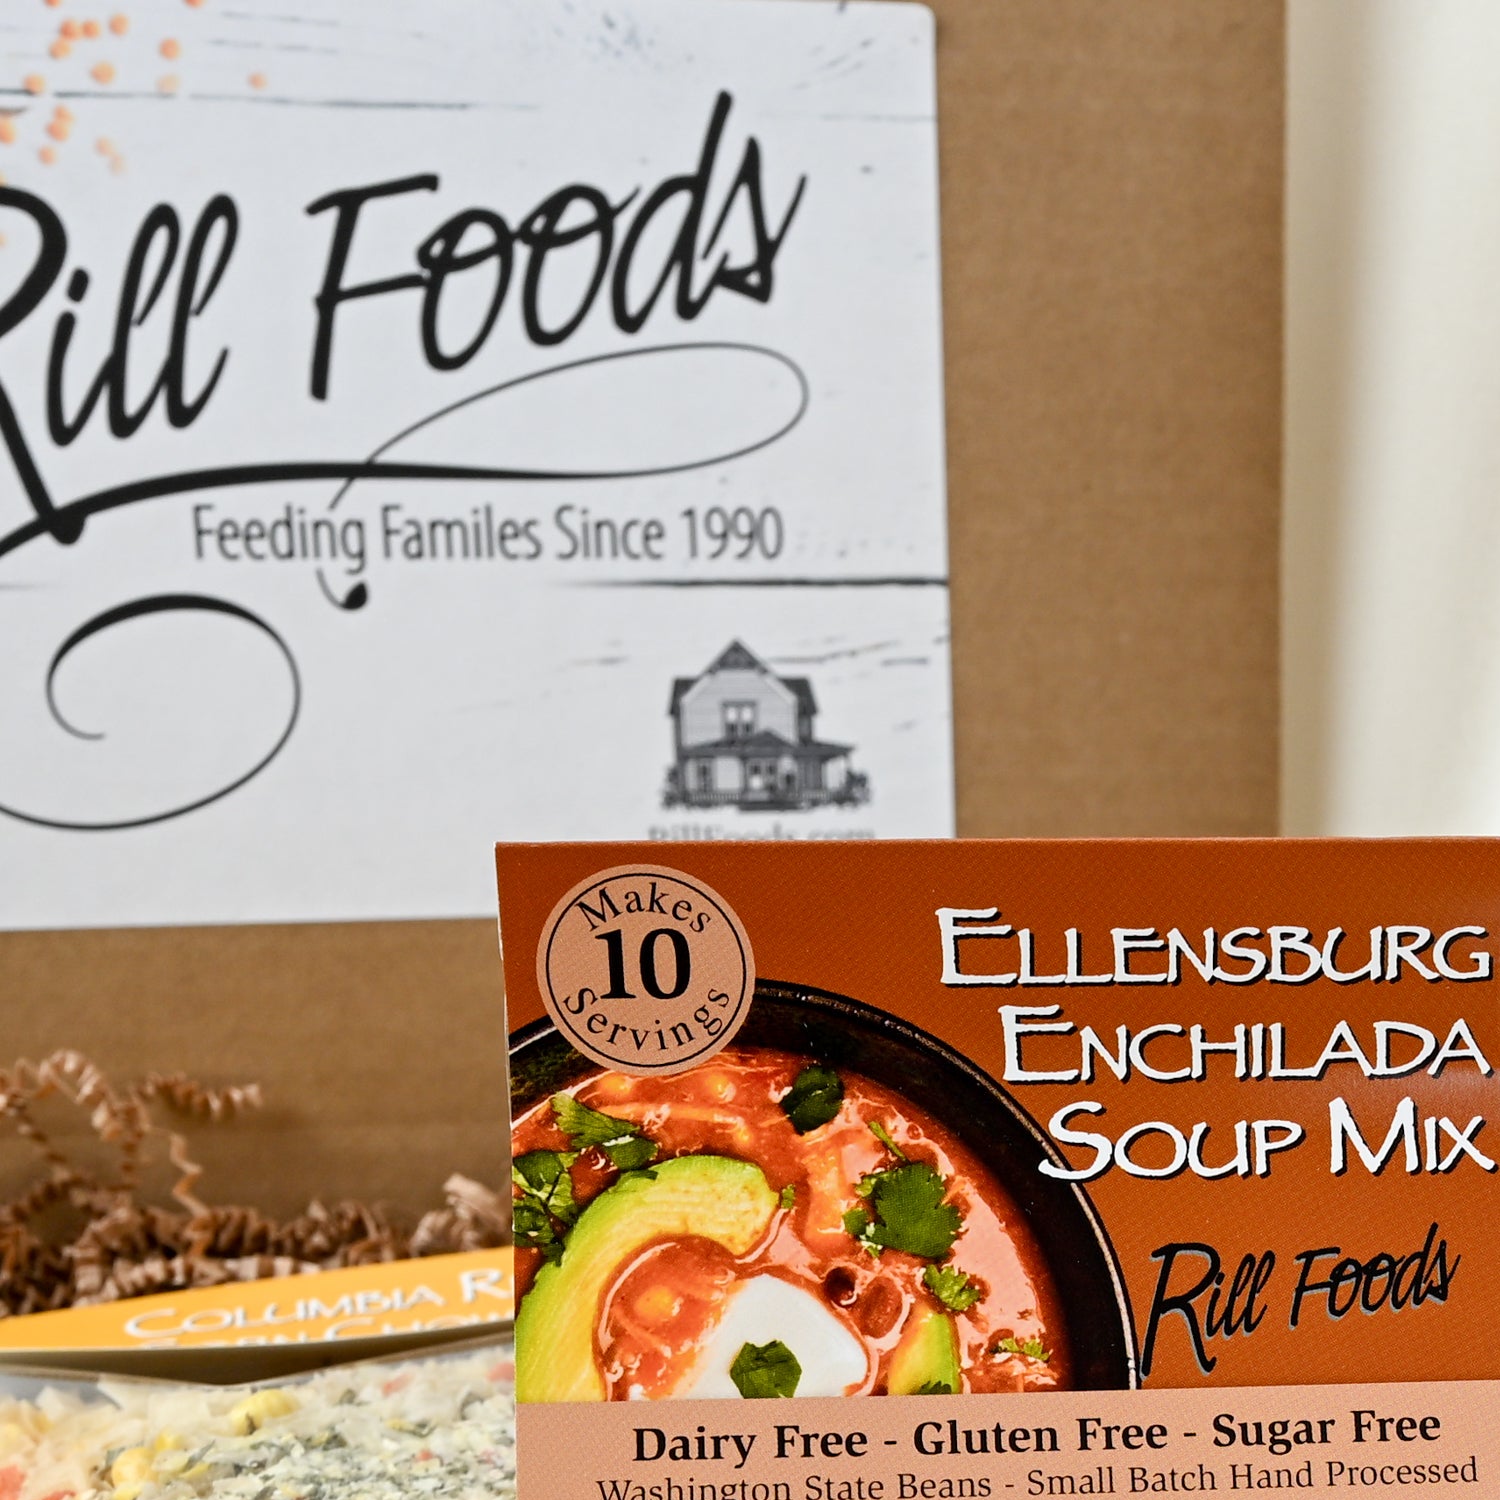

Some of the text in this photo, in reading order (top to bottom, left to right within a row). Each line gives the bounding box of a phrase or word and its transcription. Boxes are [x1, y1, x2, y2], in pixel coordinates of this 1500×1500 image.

[305, 90, 806, 400] Foods
[193, 503, 784, 575] Feeding Familes Since 1990
[575, 882, 711, 933] Makes
[595, 928, 691, 1000] 10
[935, 907, 1493, 985] ELLENSBURG
[563, 986, 730, 1052] Servings
[998, 1004, 1494, 1083] ENCHILADA
[1038, 1096, 1497, 1181] SOUP MIX
[124, 1285, 446, 1339] COLUMBIA
[1141, 1222, 1461, 1377] Rill Foods
[632, 1426, 757, 1469] Dairy
[774, 1425, 868, 1458] Free
[913, 1420, 1058, 1455] Gluten
[1076, 1417, 1168, 1451] Free
[1213, 1413, 1335, 1455] Sugar
[1351, 1410, 1441, 1444] Free
[897, 1472, 992, 1500] Beans
[1028, 1467, 1115, 1495] Small
[1128, 1464, 1216, 1493] Batch
[1230, 1461, 1313, 1490] Hand
[1326, 1456, 1479, 1487] Processed
